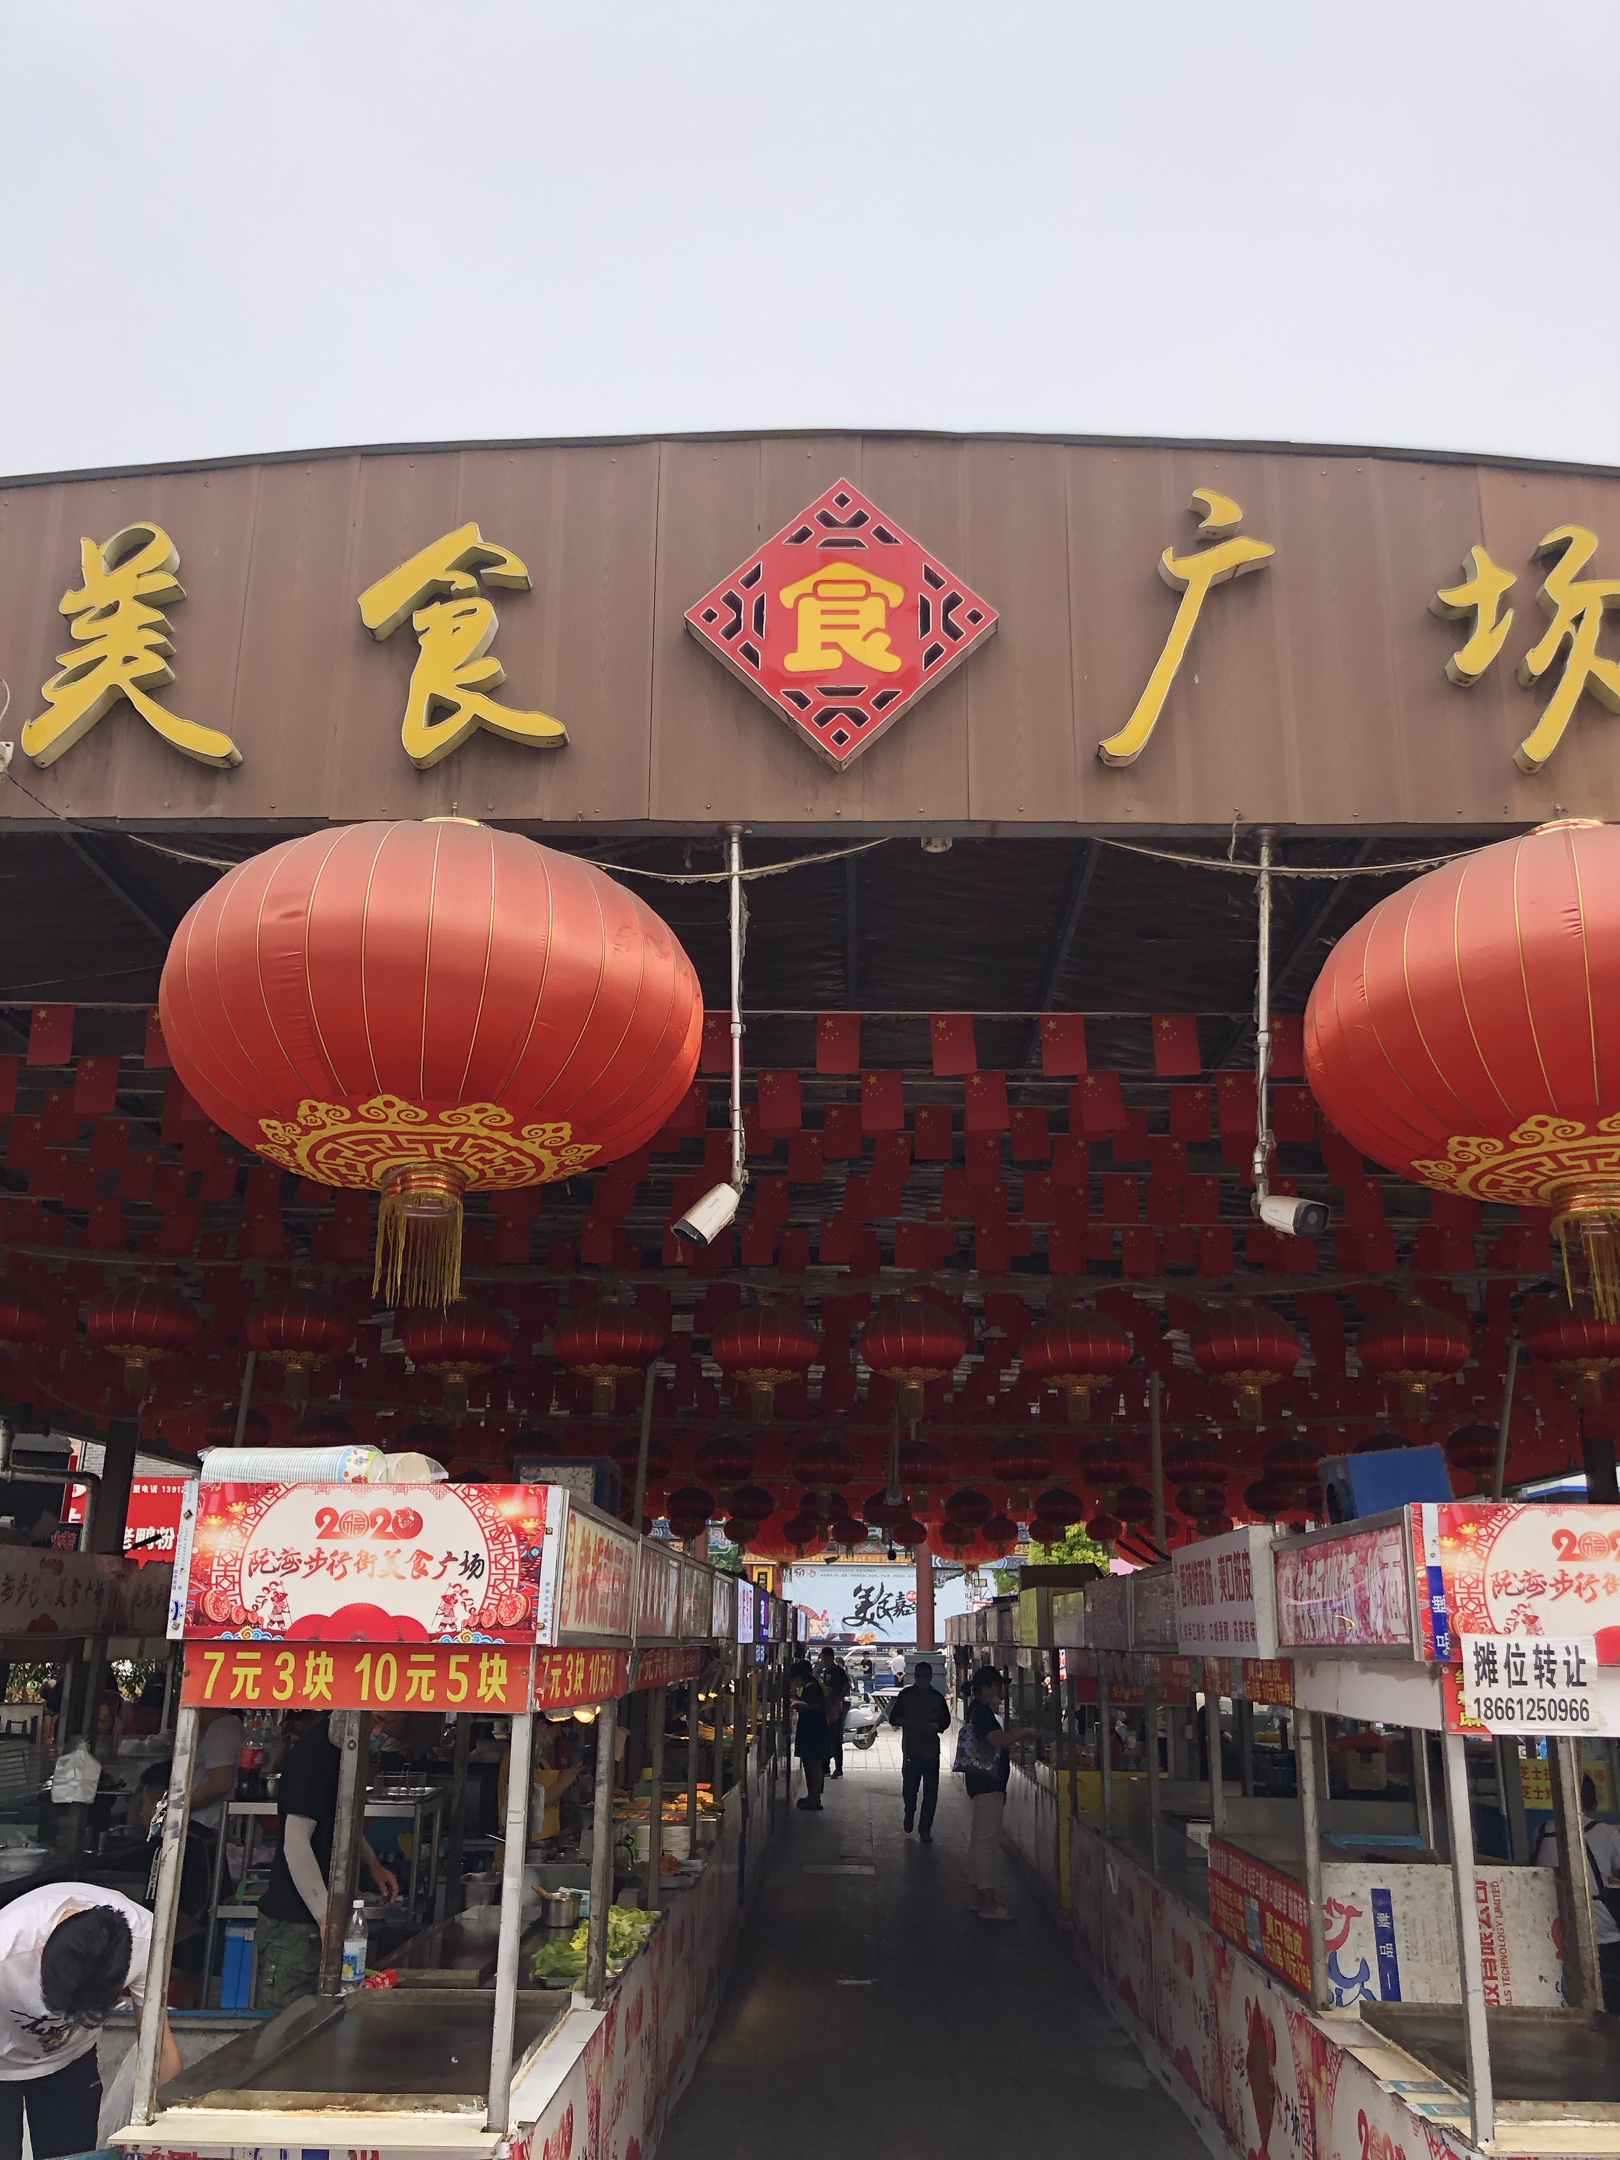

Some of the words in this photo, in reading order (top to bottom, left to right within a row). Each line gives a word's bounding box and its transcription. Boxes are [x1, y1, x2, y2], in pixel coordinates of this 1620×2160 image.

[779, 561, 905, 673] 食
[314, 1506, 424, 1540] 2020
[247, 1547, 486, 1581] 陇海步行街美食广场
[203, 1650, 335, 1702] 7元3块
[354, 1652, 508, 1704] 10元5块
[1473, 1640, 1588, 1689] 摊位转让
[1473, 1696, 1590, 1722] 18661250966
[1491, 1880, 1503, 1919] LIMITED
[1496, 1921, 1512, 1987] TECHNOLOGY
